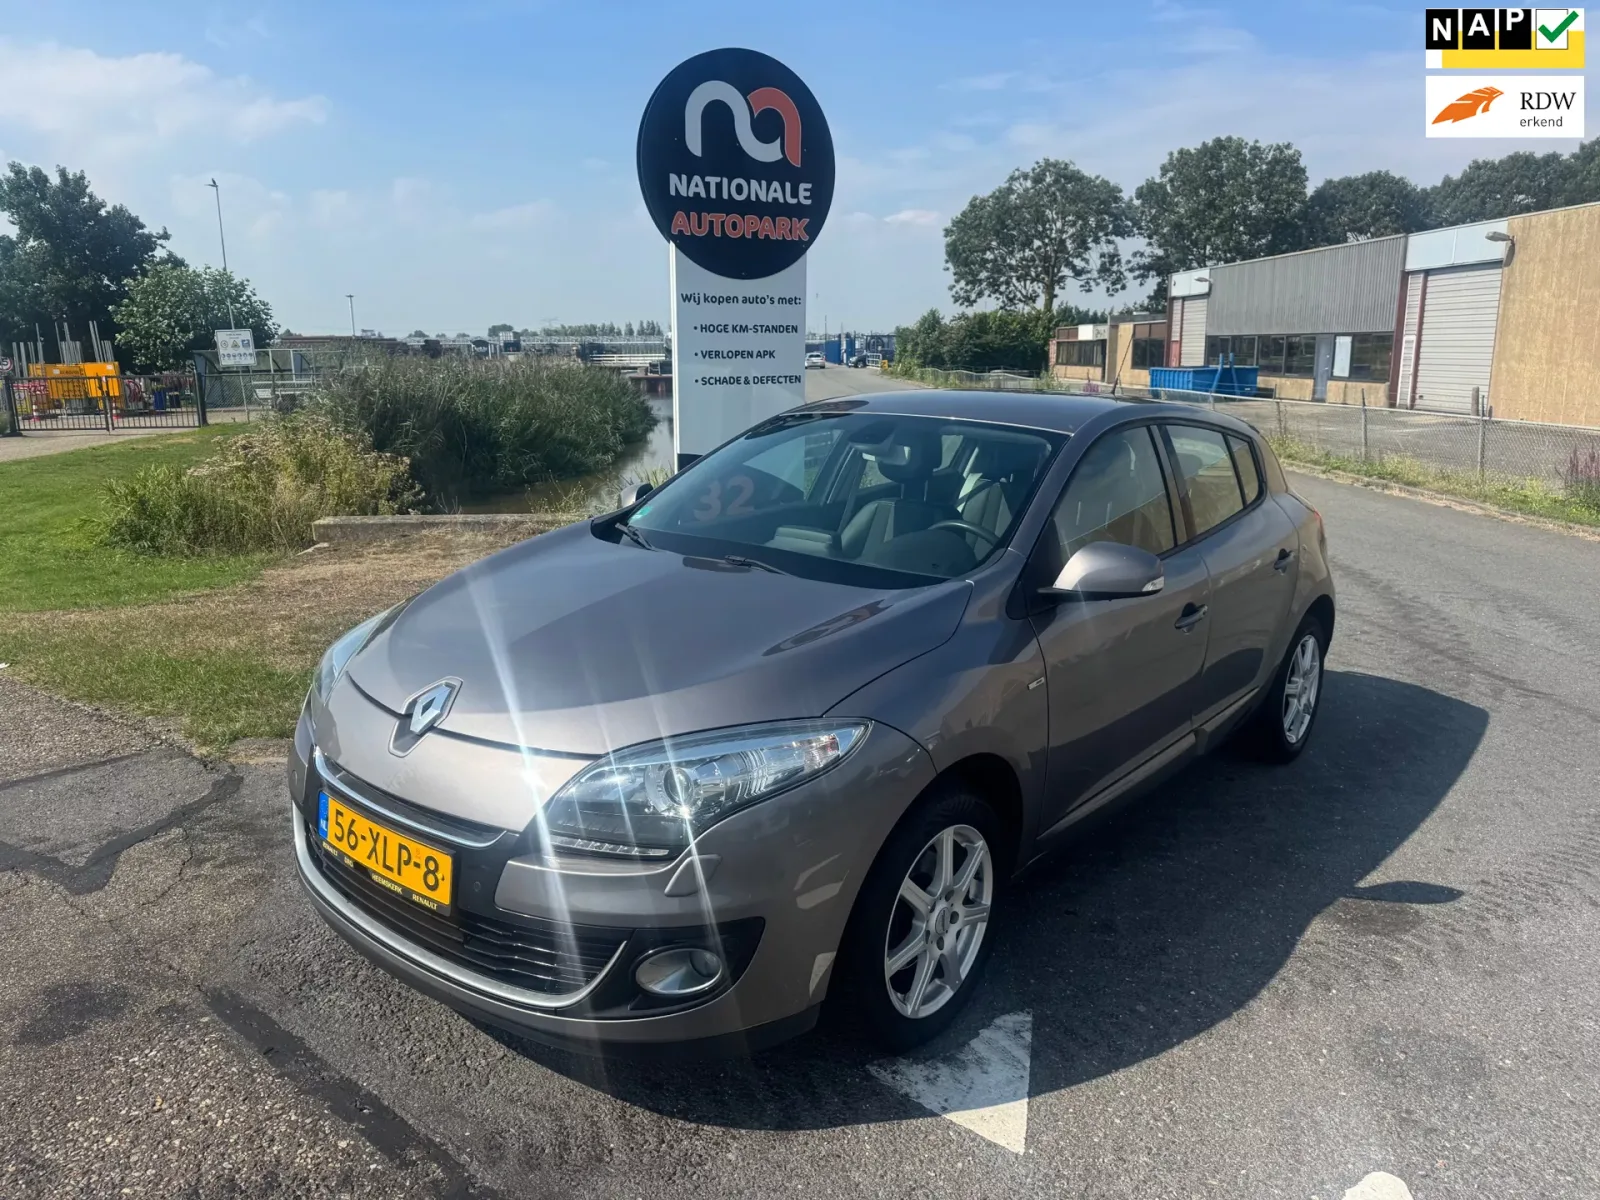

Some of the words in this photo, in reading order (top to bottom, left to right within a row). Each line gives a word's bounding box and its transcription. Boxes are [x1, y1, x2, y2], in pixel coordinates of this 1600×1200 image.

[669, 173, 813, 205] NATIONALE
[671, 210, 810, 241] AUTOPARK
[681, 293, 701, 306] Wij
[703, 293, 739, 306] kopen
[742, 295, 775, 305] auto's
[777, 295, 802, 305] met:
[700, 324, 730, 333] HOGE
[732, 324, 798, 334] KM-STANDEN
[700, 350, 754, 359] VERLOPEN
[755, 350, 776, 359] APK
[701, 376, 742, 386] SCHADE
[743, 376, 751, 385] &
[753, 375, 802, 385] DEFECTEN
[693, 474, 755, 521] 32
[334, 808, 440, 891] 56-XLP-8
[371, 873, 403, 895] HEEMSKERK
[412, 893, 438, 911] RENAULT
